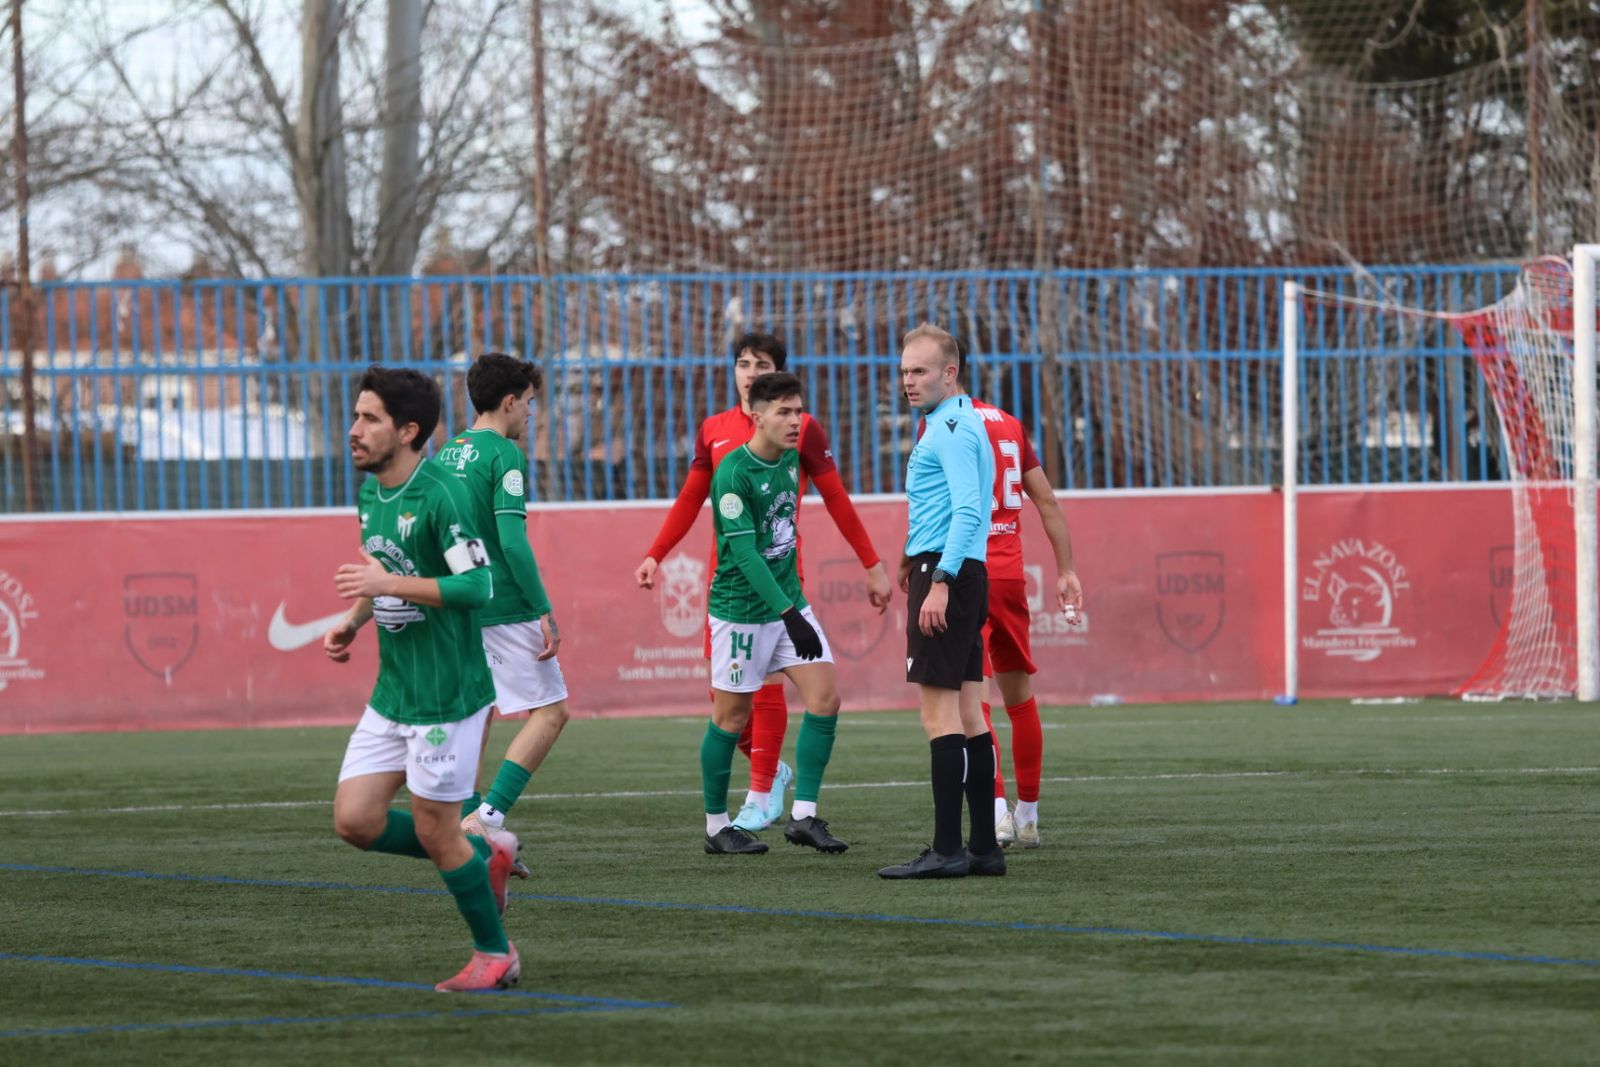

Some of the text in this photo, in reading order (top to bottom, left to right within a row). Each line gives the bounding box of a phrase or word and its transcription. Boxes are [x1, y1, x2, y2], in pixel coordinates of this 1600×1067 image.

[819, 580, 867, 603] UDS
[1156, 573, 1225, 595] UDSM
[123, 594, 198, 618] UDSM
[730, 631, 754, 661] 14
[617, 665, 653, 680] Santa
[416, 754, 456, 764] BEHER
